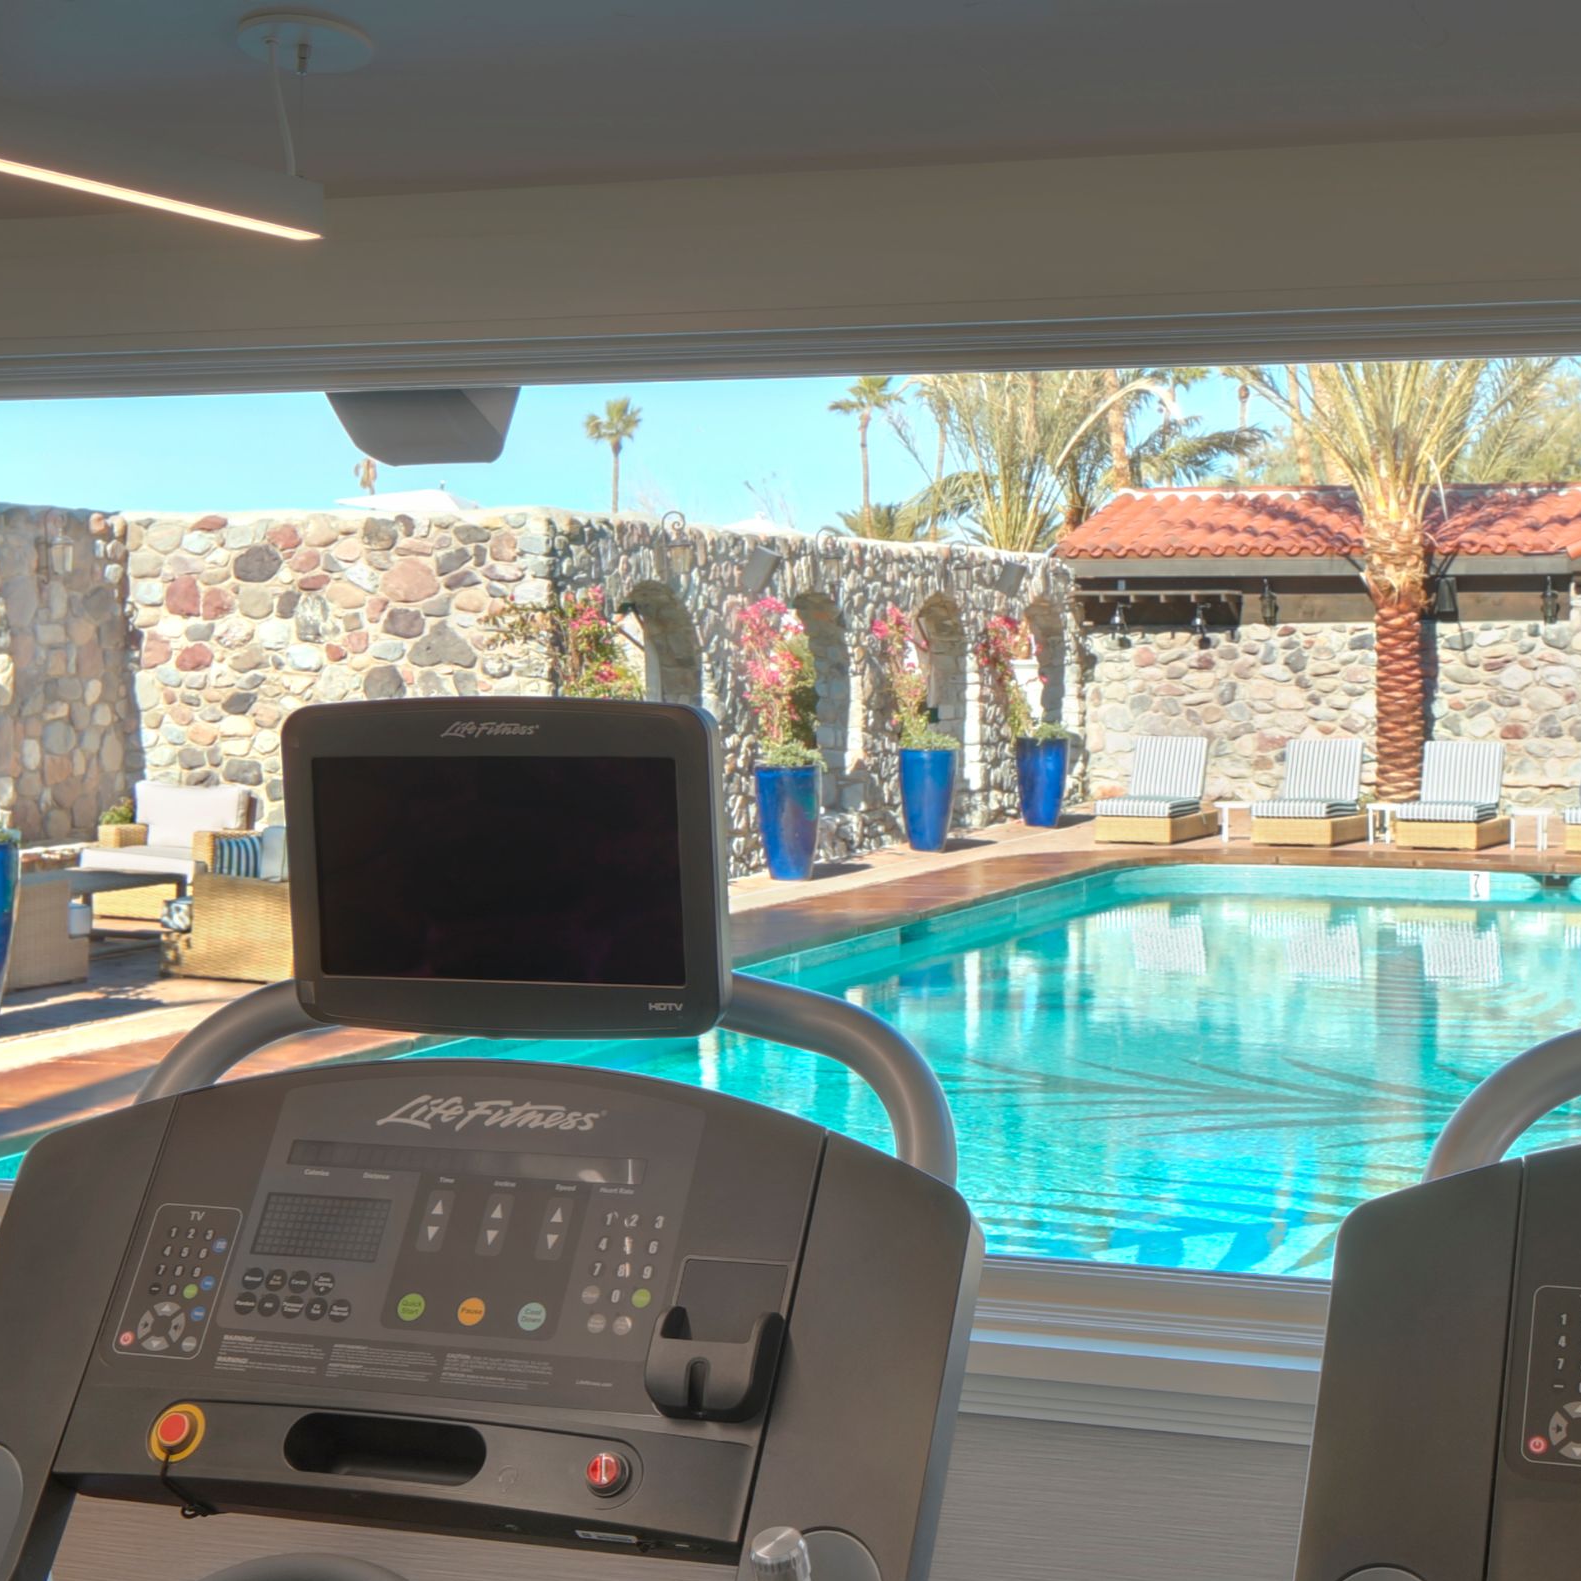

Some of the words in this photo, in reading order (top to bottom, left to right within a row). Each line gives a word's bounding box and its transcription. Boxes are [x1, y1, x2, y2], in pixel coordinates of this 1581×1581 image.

[648, 1002, 683, 1011] HDTV
[189, 1211, 205, 1221] TV
[606, 1212, 613, 1225] 1
[630, 1214, 639, 1227] 2
[654, 1216, 665, 1229] 3
[171, 1227, 178, 1238] 1
[187, 1229, 195, 1239] 2
[206, 1230, 214, 1240] 3
[598, 1237, 608, 1251] 4
[649, 1241, 658, 1254] 6
[164, 1247, 172, 1257] 4
[181, 1247, 189, 1257] 5
[199, 1248, 207, 1258] 6
[158, 1265, 166, 1275] 7
[175, 1266, 183, 1276] 8
[193, 1267, 201, 1277] 9
[593, 1263, 602, 1276] 7
[642, 1266, 652, 1279] 9
[611, 1289, 620, 1303] 0
[461, 1307, 483, 1315] Pause
[1560, 1314, 1567, 1325] 1
[1558, 1336, 1567, 1348] 4
[1557, 1358, 1565, 1370] 7
